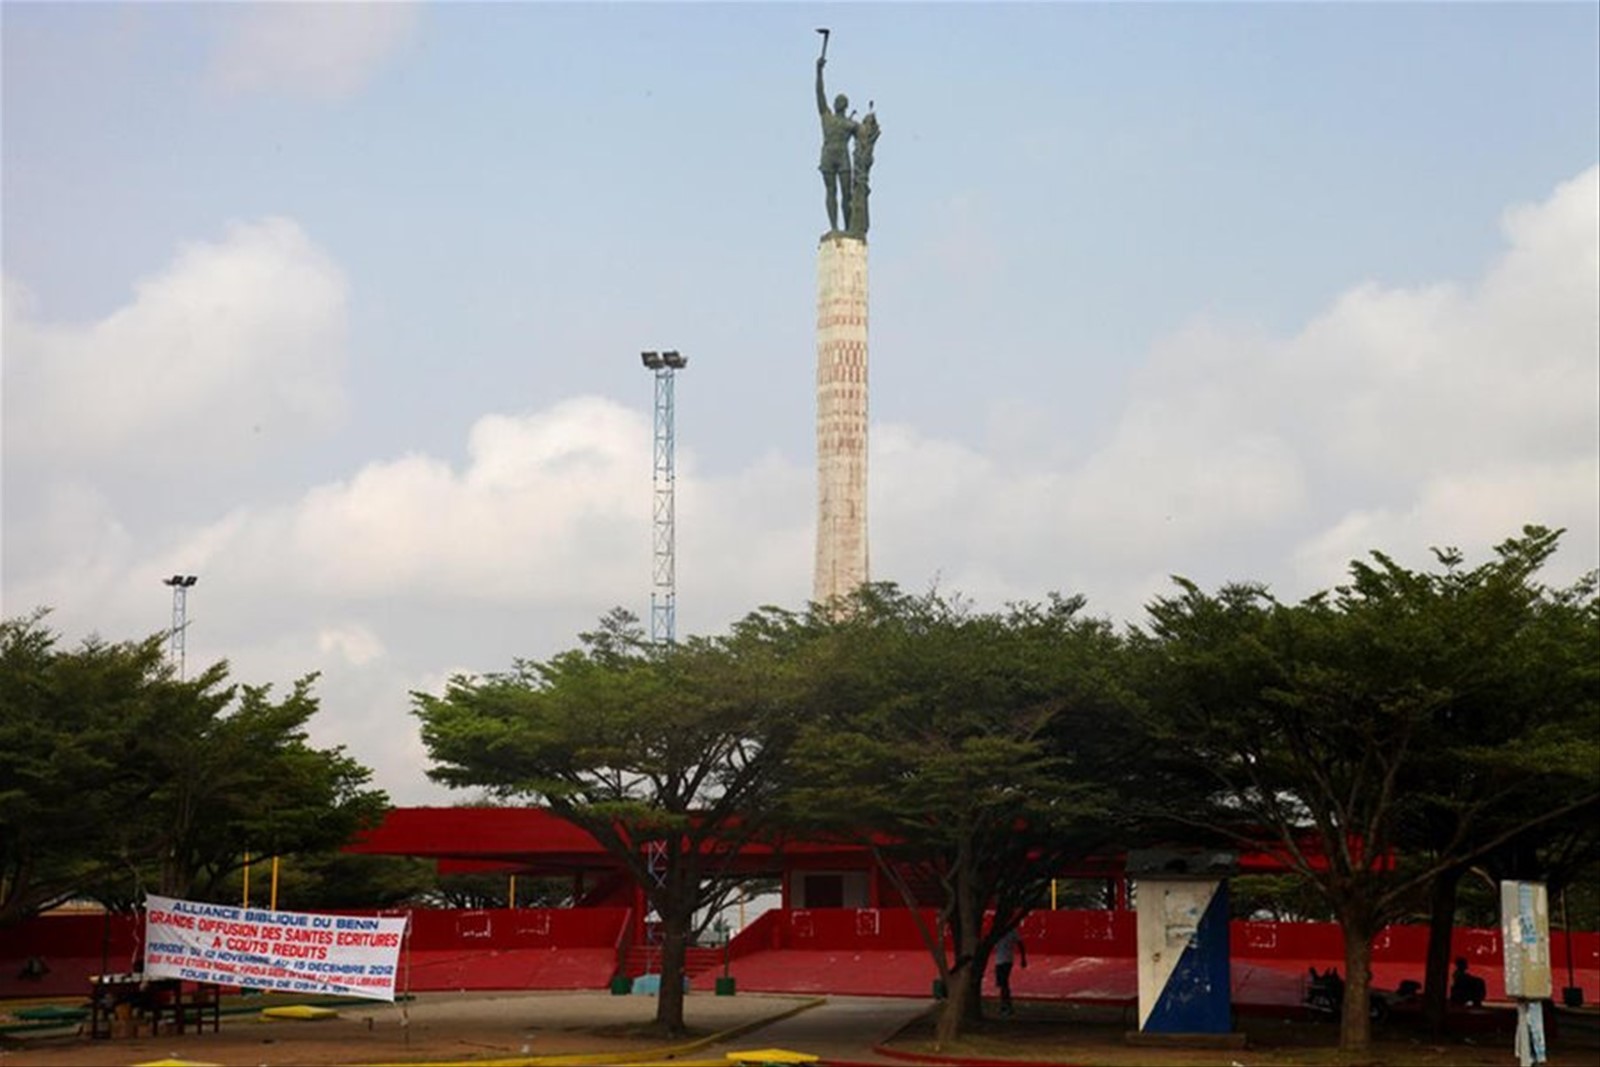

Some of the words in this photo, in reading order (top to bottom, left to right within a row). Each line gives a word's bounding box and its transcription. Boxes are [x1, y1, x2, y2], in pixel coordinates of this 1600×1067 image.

[172, 902, 240, 919] ALLIANCE
[245, 911, 308, 926] BIBLIQUE
[313, 917, 332, 928] DU
[336, 919, 379, 930] BENIN
[149, 910, 194, 929] GRANDE
[198, 918, 257, 937] DIFFUSION
[261, 926, 282, 940] DES
[285, 928, 333, 945] SAINTES
[336, 932, 399, 947] ECRITURES
[226, 938, 268, 953] COUTS
[273, 943, 327, 960] REDUITS
[180, 968, 208, 980] TOUS
[211, 973, 234, 983] LES
[273, 959, 289, 968] AU
[294, 961, 305, 970] 15
[308, 962, 365, 974] DECEMBRE
[368, 965, 394, 975] 2012
